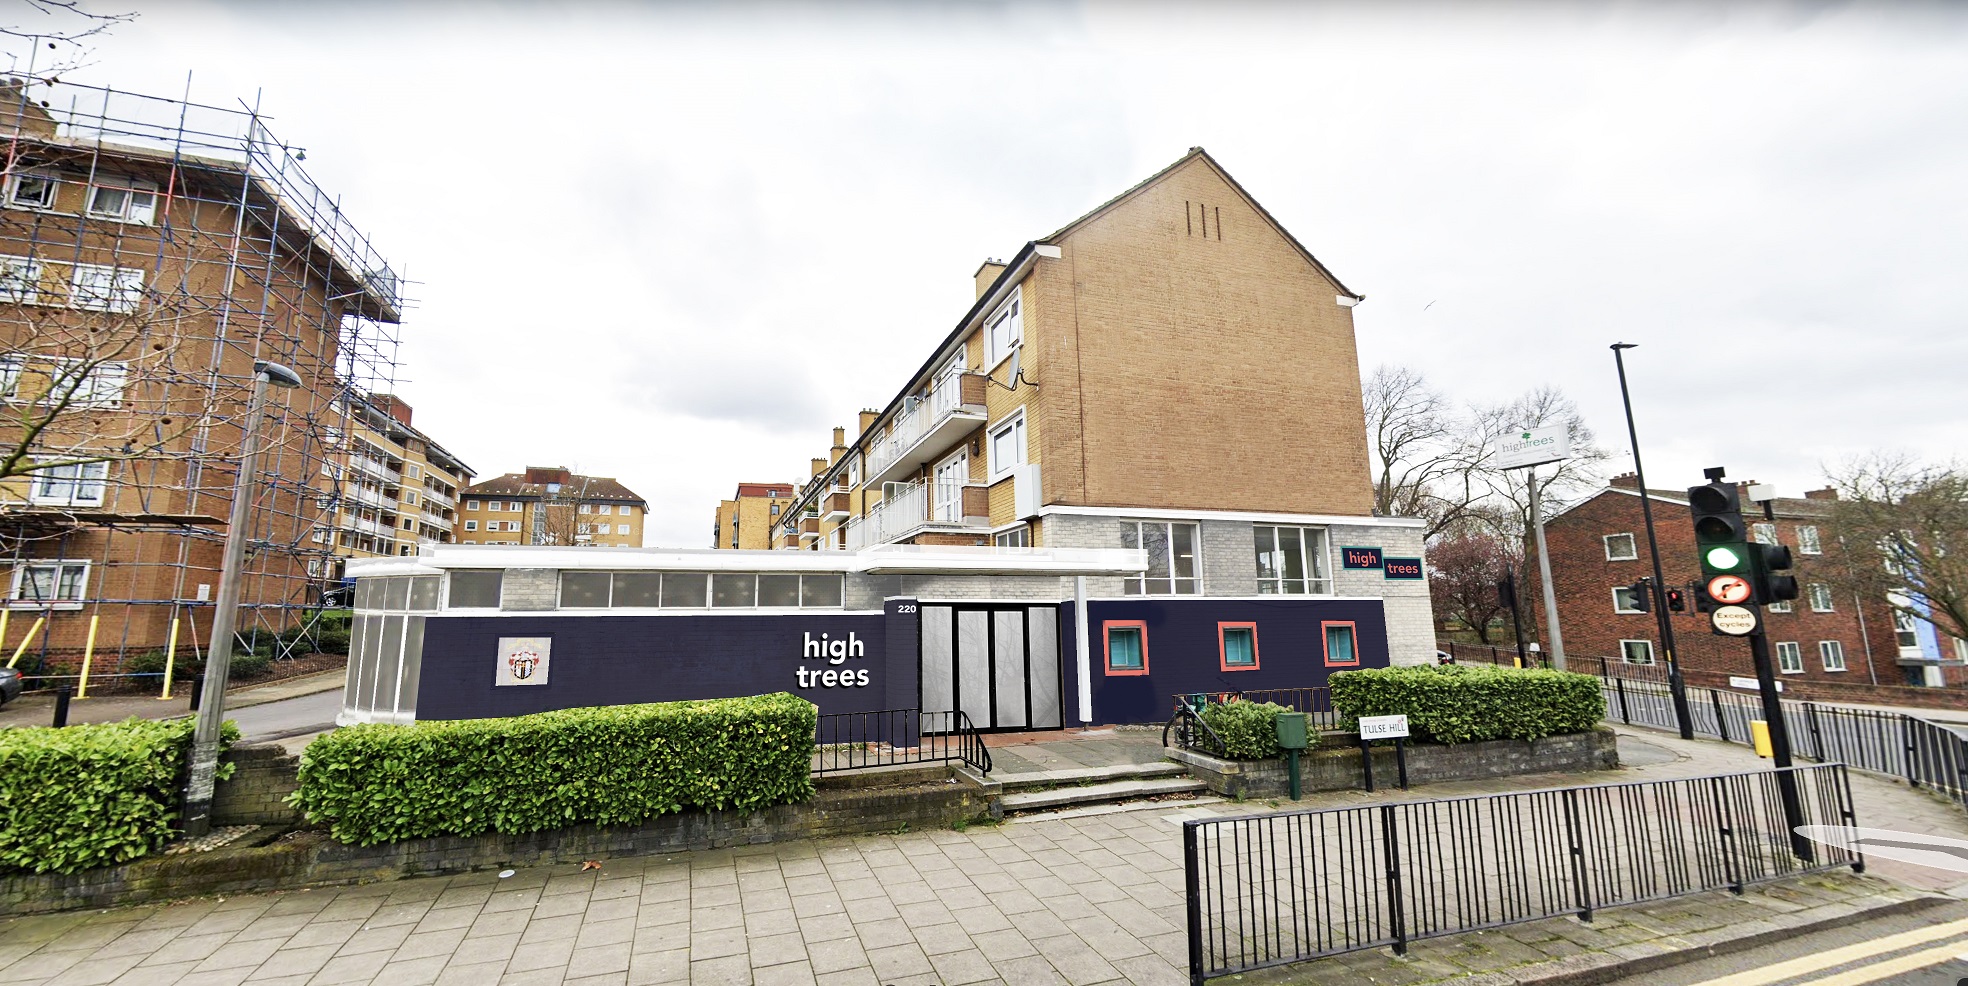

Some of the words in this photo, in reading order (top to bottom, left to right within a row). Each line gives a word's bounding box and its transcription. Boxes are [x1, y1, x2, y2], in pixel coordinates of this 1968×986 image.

[1348, 550, 1377, 567] high
[1387, 563, 1419, 574] trees
[897, 604, 917, 613] 220
[1716, 612, 1751, 620] Except
[803, 631, 864, 665] high
[795, 665, 870, 688] trees
[1363, 724, 1387, 734] TULSE
[1389, 723, 1406, 732] HILL
